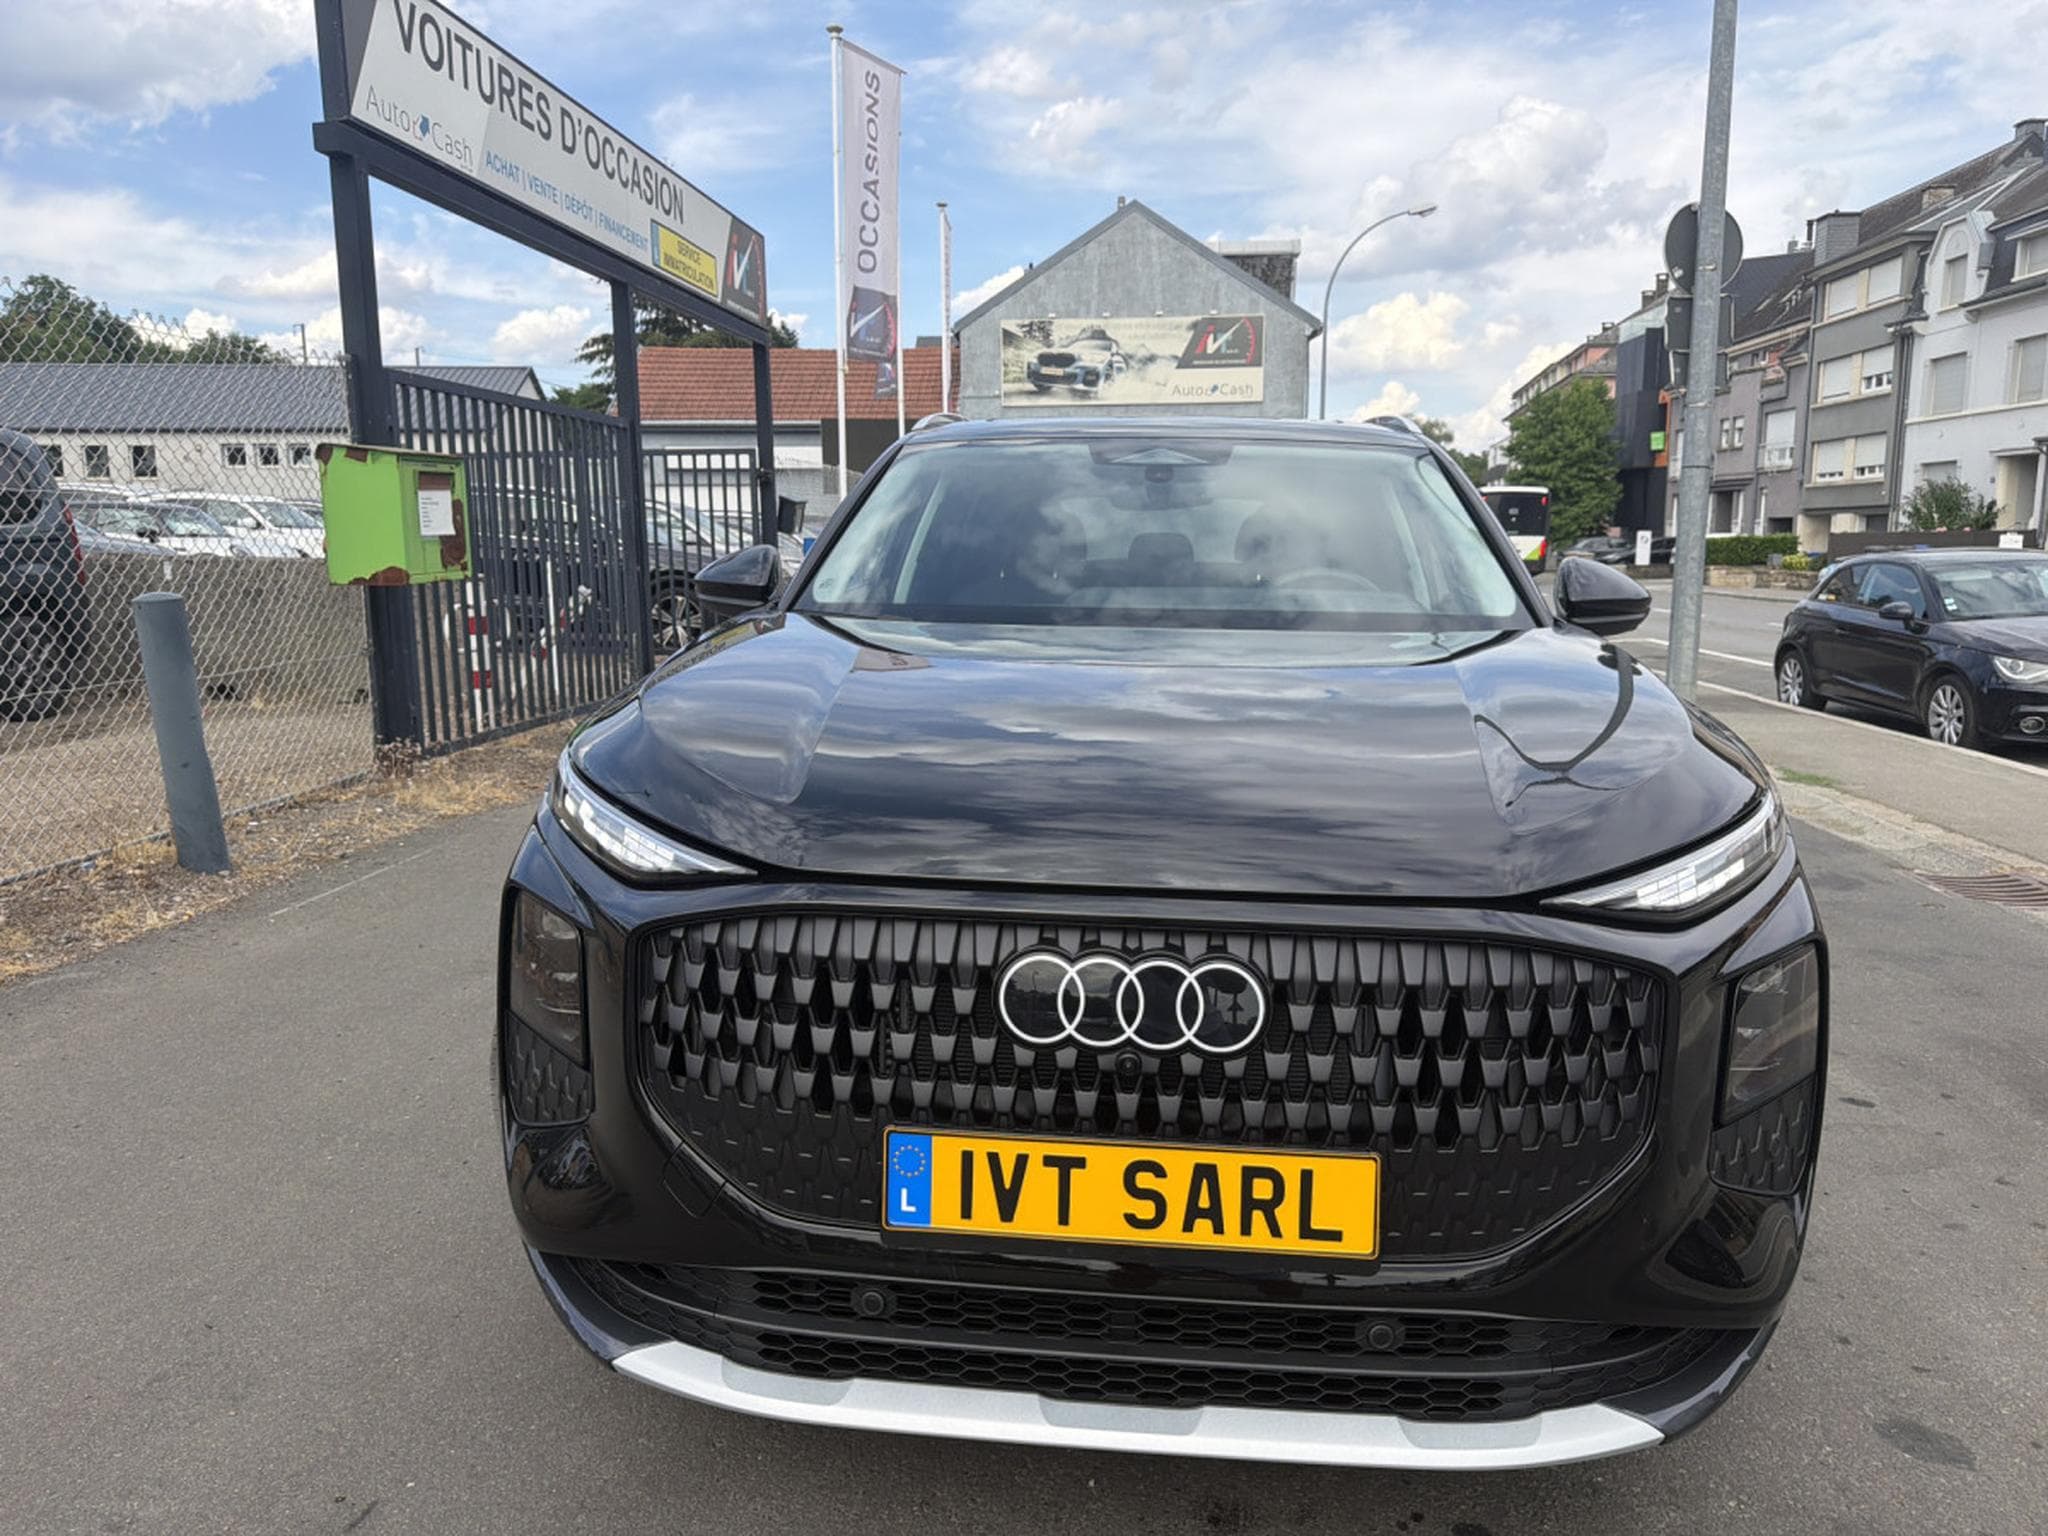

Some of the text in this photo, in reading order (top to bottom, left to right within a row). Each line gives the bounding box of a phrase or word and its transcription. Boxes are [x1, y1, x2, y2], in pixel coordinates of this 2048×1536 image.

[394, 0, 685, 225] VOITURES D'OCCASION
[486, 150, 520, 183] ACHAT
[527, 173, 559, 204] VENTE
[600, 208, 648, 249] FINANCEMENT
[857, 69, 881, 274] OCCASIONS
[1220, 383, 1254, 397] Cash
[900, 1149, 1344, 1243] L IVT SARL
